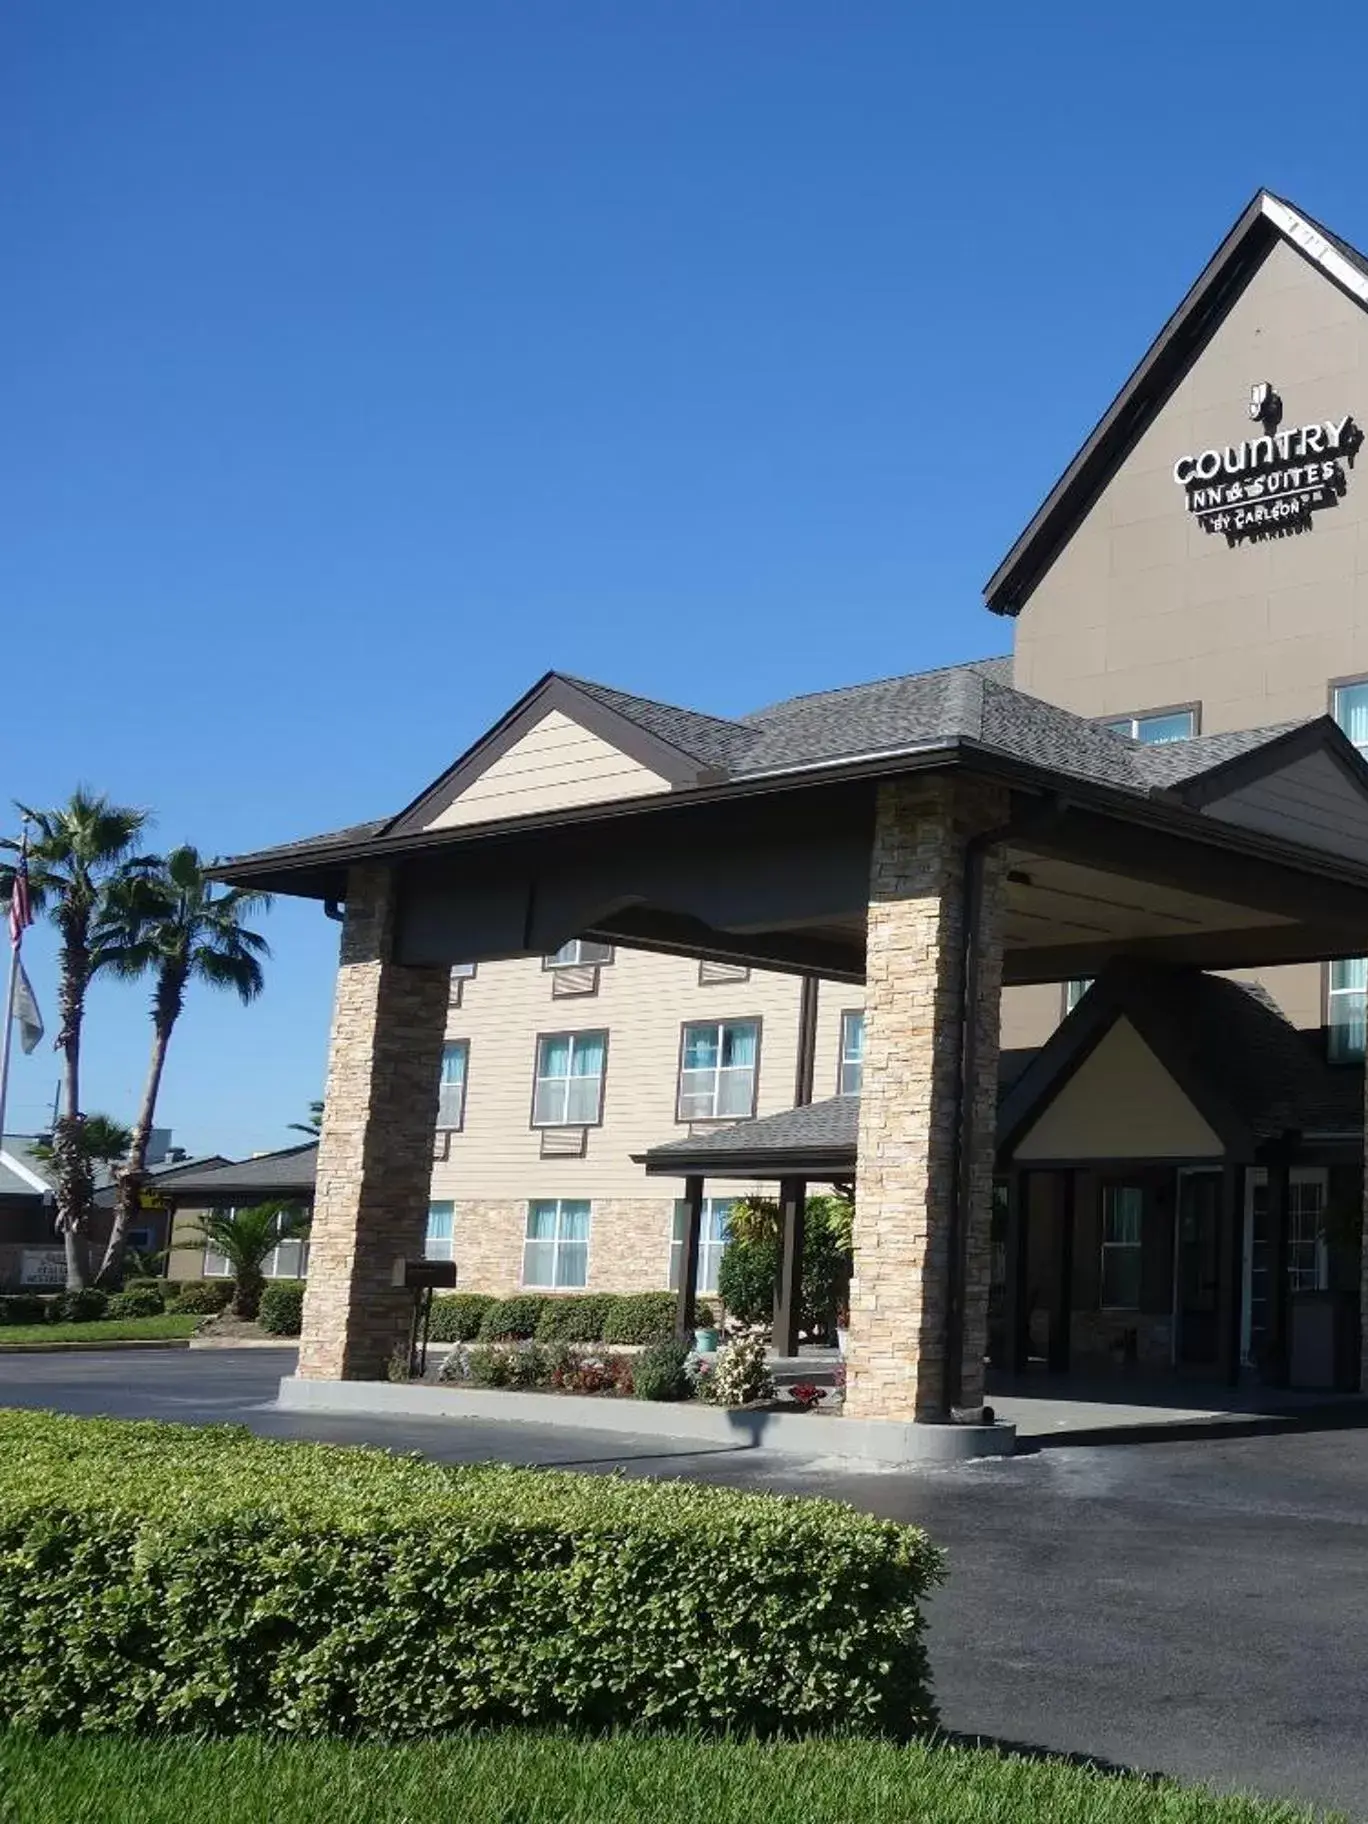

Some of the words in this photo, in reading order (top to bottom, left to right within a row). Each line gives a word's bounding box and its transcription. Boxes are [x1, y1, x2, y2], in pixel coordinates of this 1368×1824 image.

[1173, 416, 1352, 484] COUNTRY
[1184, 484, 1225, 511] INN
[1228, 482, 1244, 501] &
[1246, 461, 1335, 496] SUITES
[1213, 513, 1231, 531] BY
[1235, 501, 1300, 529] CARLSON
